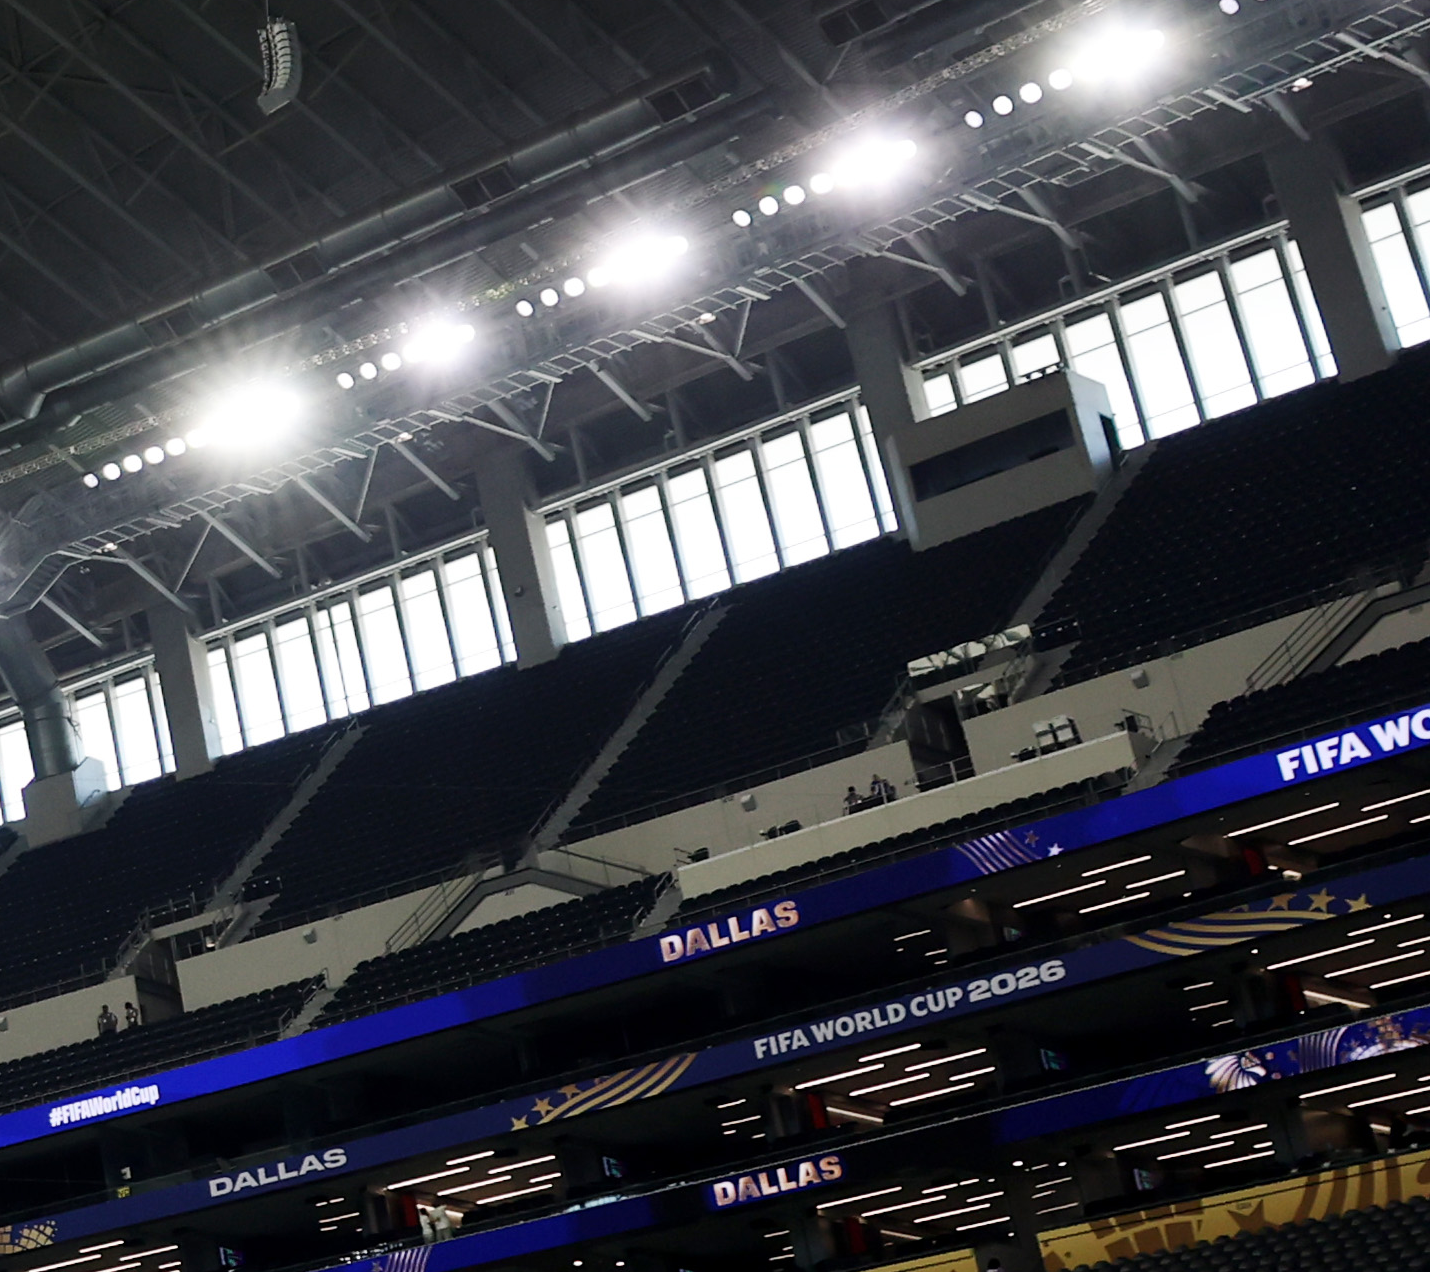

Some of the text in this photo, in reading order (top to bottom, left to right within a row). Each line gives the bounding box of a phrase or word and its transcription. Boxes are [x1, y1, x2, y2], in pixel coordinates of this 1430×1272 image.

[1277, 733, 1371, 781] FIFA
[660, 901, 798, 962] DALLAS
[754, 960, 1065, 1059] FIFA WORLD CUP 2026
[49, 1085, 159, 1127] #FIFAWorldCup
[209, 1149, 346, 1197] DALLAS
[712, 1156, 842, 1207] DALLAS
